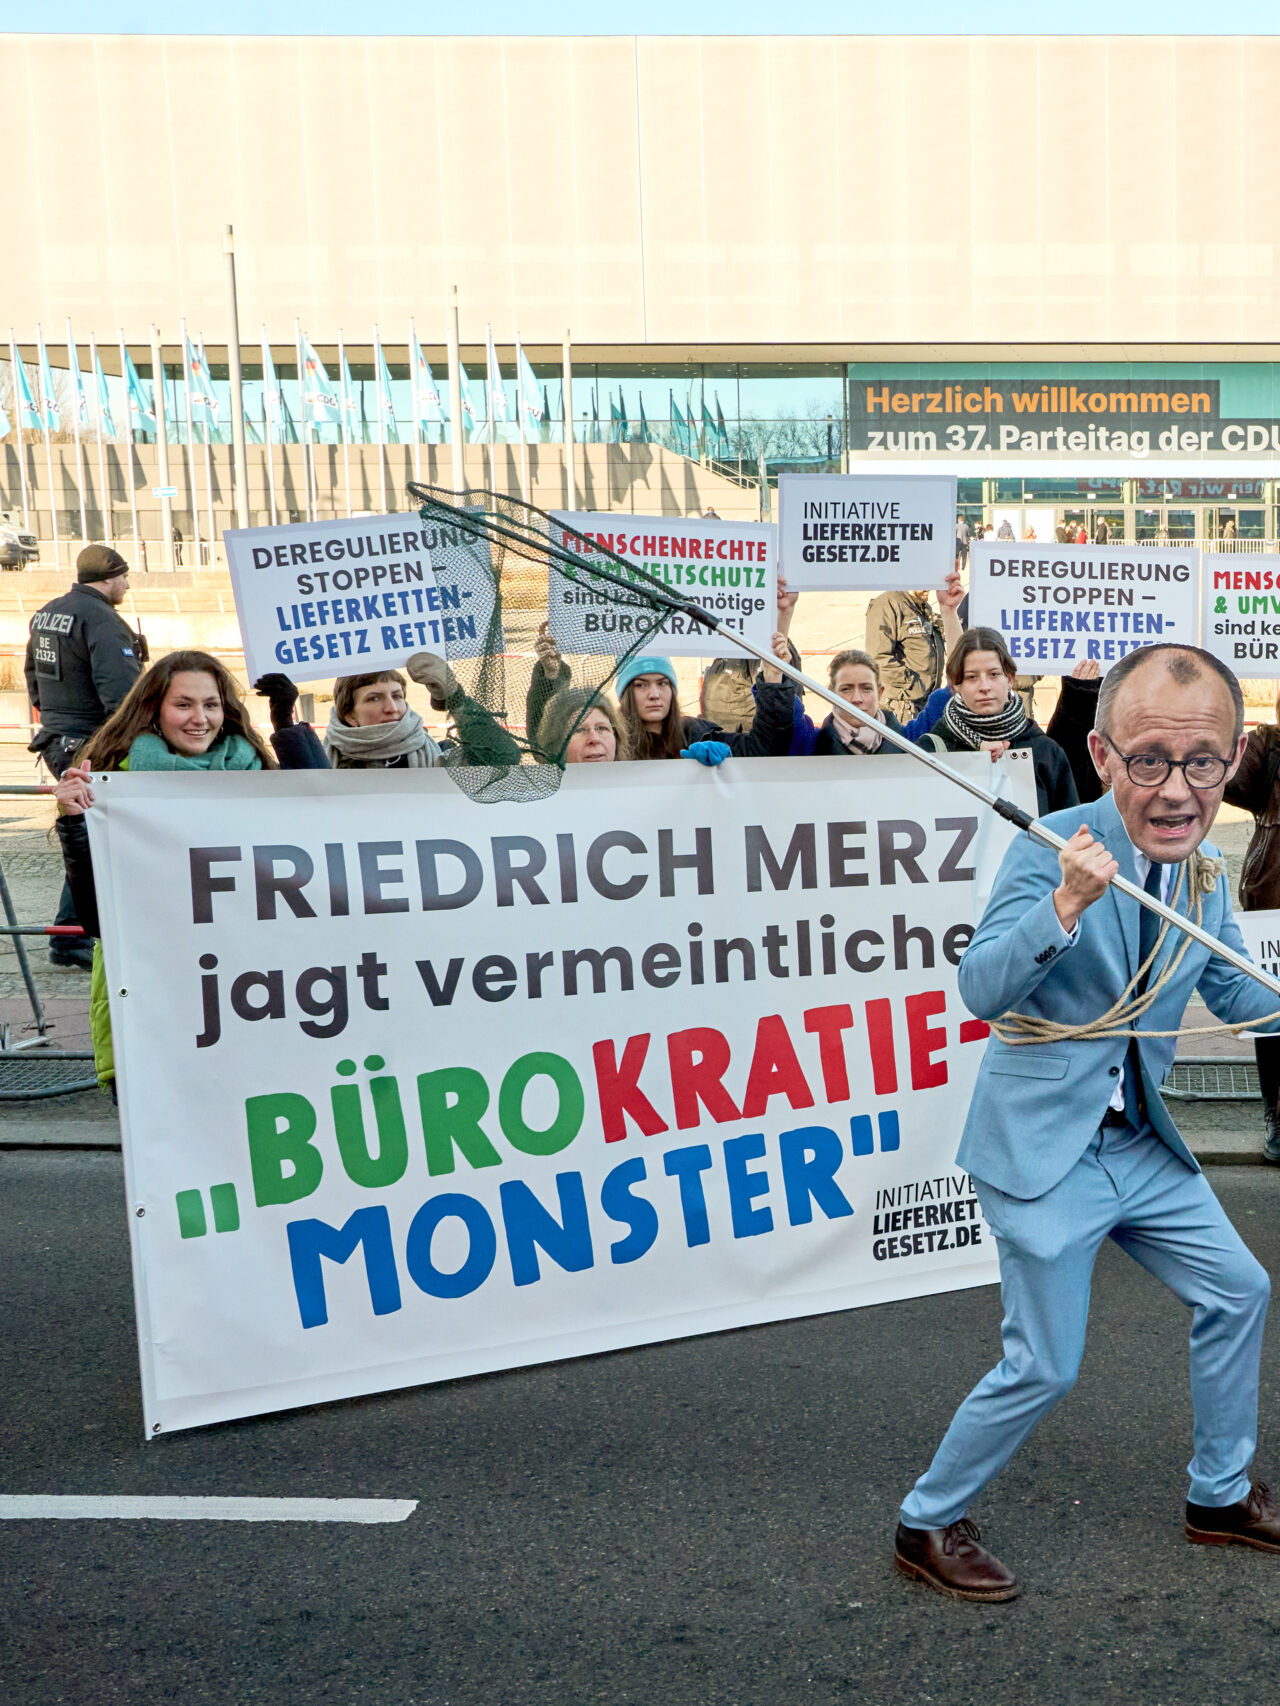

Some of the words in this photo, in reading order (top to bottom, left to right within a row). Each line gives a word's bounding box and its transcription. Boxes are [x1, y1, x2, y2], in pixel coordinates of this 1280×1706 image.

[866, 385, 1004, 414] Herzlich
[1011, 385, 1211, 414] willkommen
[867, 430, 937, 452] zum
[945, 425, 992, 452] 37.
[999, 423, 1151, 459] Parteitag
[1158, 424, 1214, 452] der
[803, 501, 901, 520] INITIATIVE
[802, 523, 933, 541] LIEFERKETTEN
[251, 528, 479, 570] DEREGULIERUNG
[562, 530, 767, 562] MENSCHENRECHTE
[802, 544, 900, 563] GESETZ.DE
[296, 560, 424, 595] STOPPEN
[989, 558, 1191, 583] DEREGULIERUNG
[276, 584, 473, 632] LIEFERKETTEN-
[563, 586, 609, 606] sind
[1022, 585, 1134, 606] STOPPEN
[1213, 595, 1228, 614] &
[31, 611, 74, 634] POLIZEI
[1000, 608, 1176, 634] LIEFERKETTEN-
[1214, 618, 1256, 635] sind
[39, 636, 50, 649] BE
[275, 628, 371, 665] GESETZ
[380, 614, 478, 651] RETTEN
[1009, 636, 1077, 659] ESETZ
[188, 826, 715, 925] FRIEDRICH
[743, 816, 979, 893] MERZ
[196, 951, 390, 1049] jagt
[414, 913, 977, 1007] vermeintliche
[876, 1174, 977, 1211] INITIATIVE
[872, 1198, 984, 1236] LIEFERKET
[872, 1223, 982, 1262] GESETZ.DE
